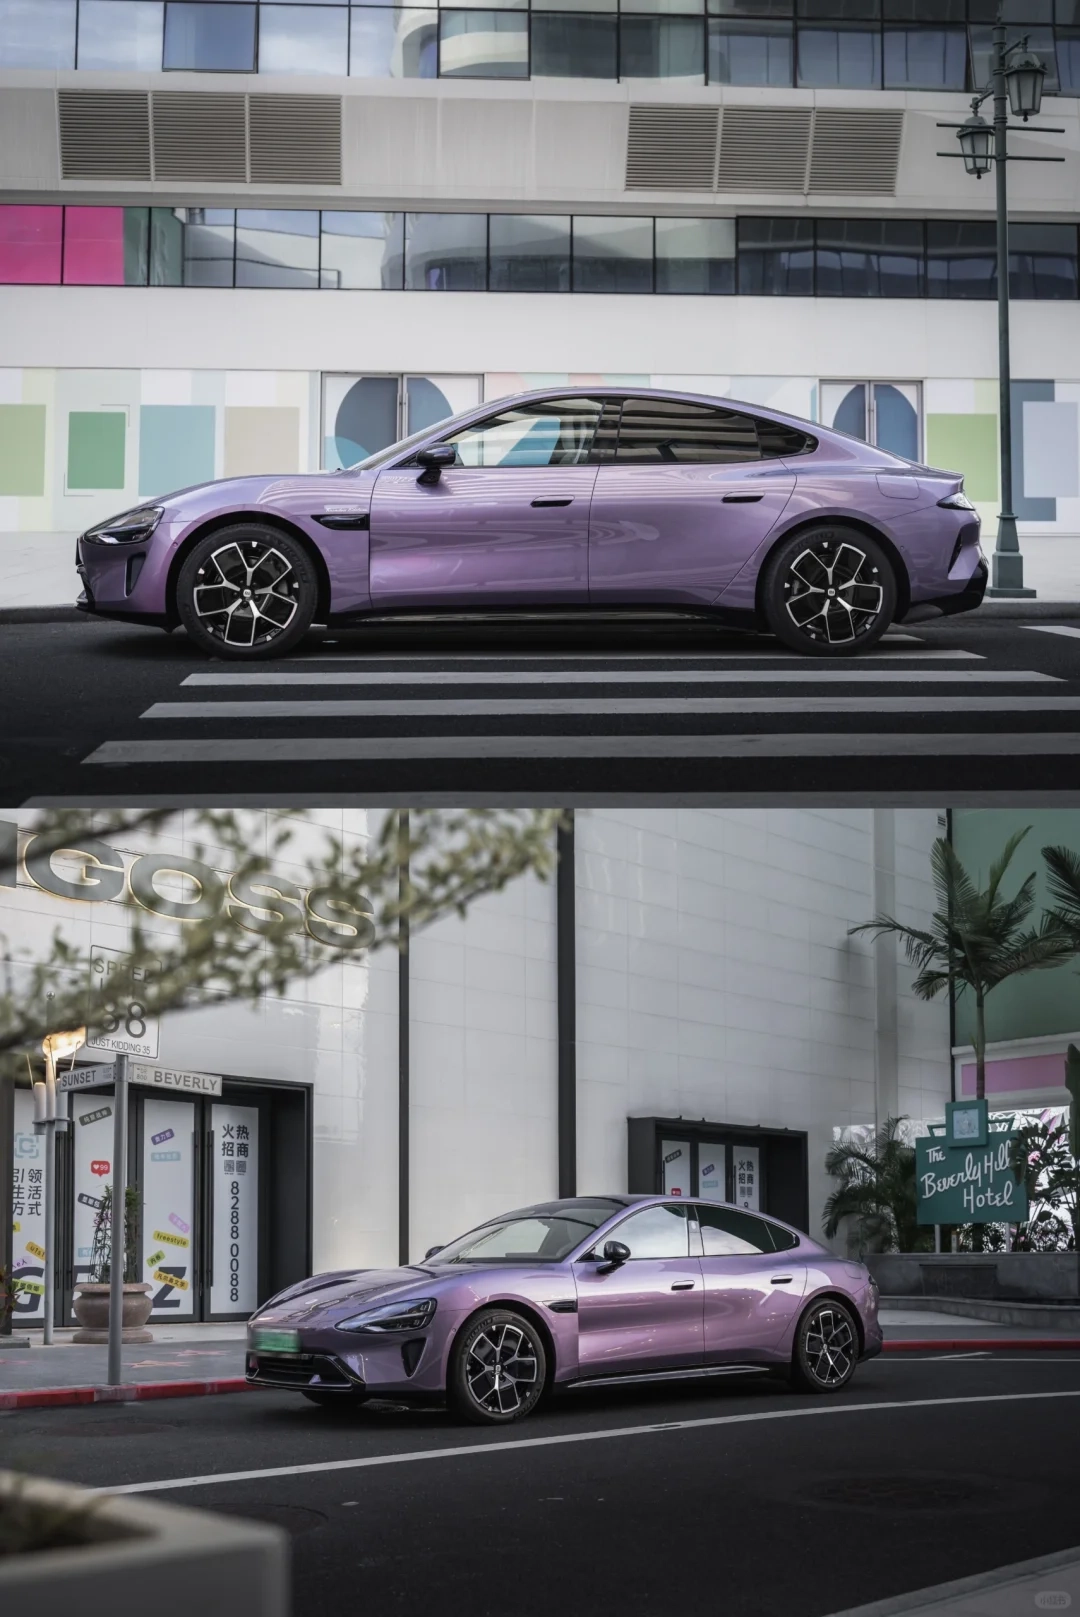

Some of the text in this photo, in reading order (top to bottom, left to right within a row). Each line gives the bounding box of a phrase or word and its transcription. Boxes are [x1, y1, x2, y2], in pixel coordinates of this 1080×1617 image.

[91, 1036, 151, 1055] JUST KIDDING 35
[62, 1070, 96, 1087] SUNSET
[154, 1071, 217, 1091] BEVERLY
[926, 1146, 946, 1163] The
[920, 1139, 1014, 1198] Beverly Hill
[963, 1180, 1013, 1214] Hotel
